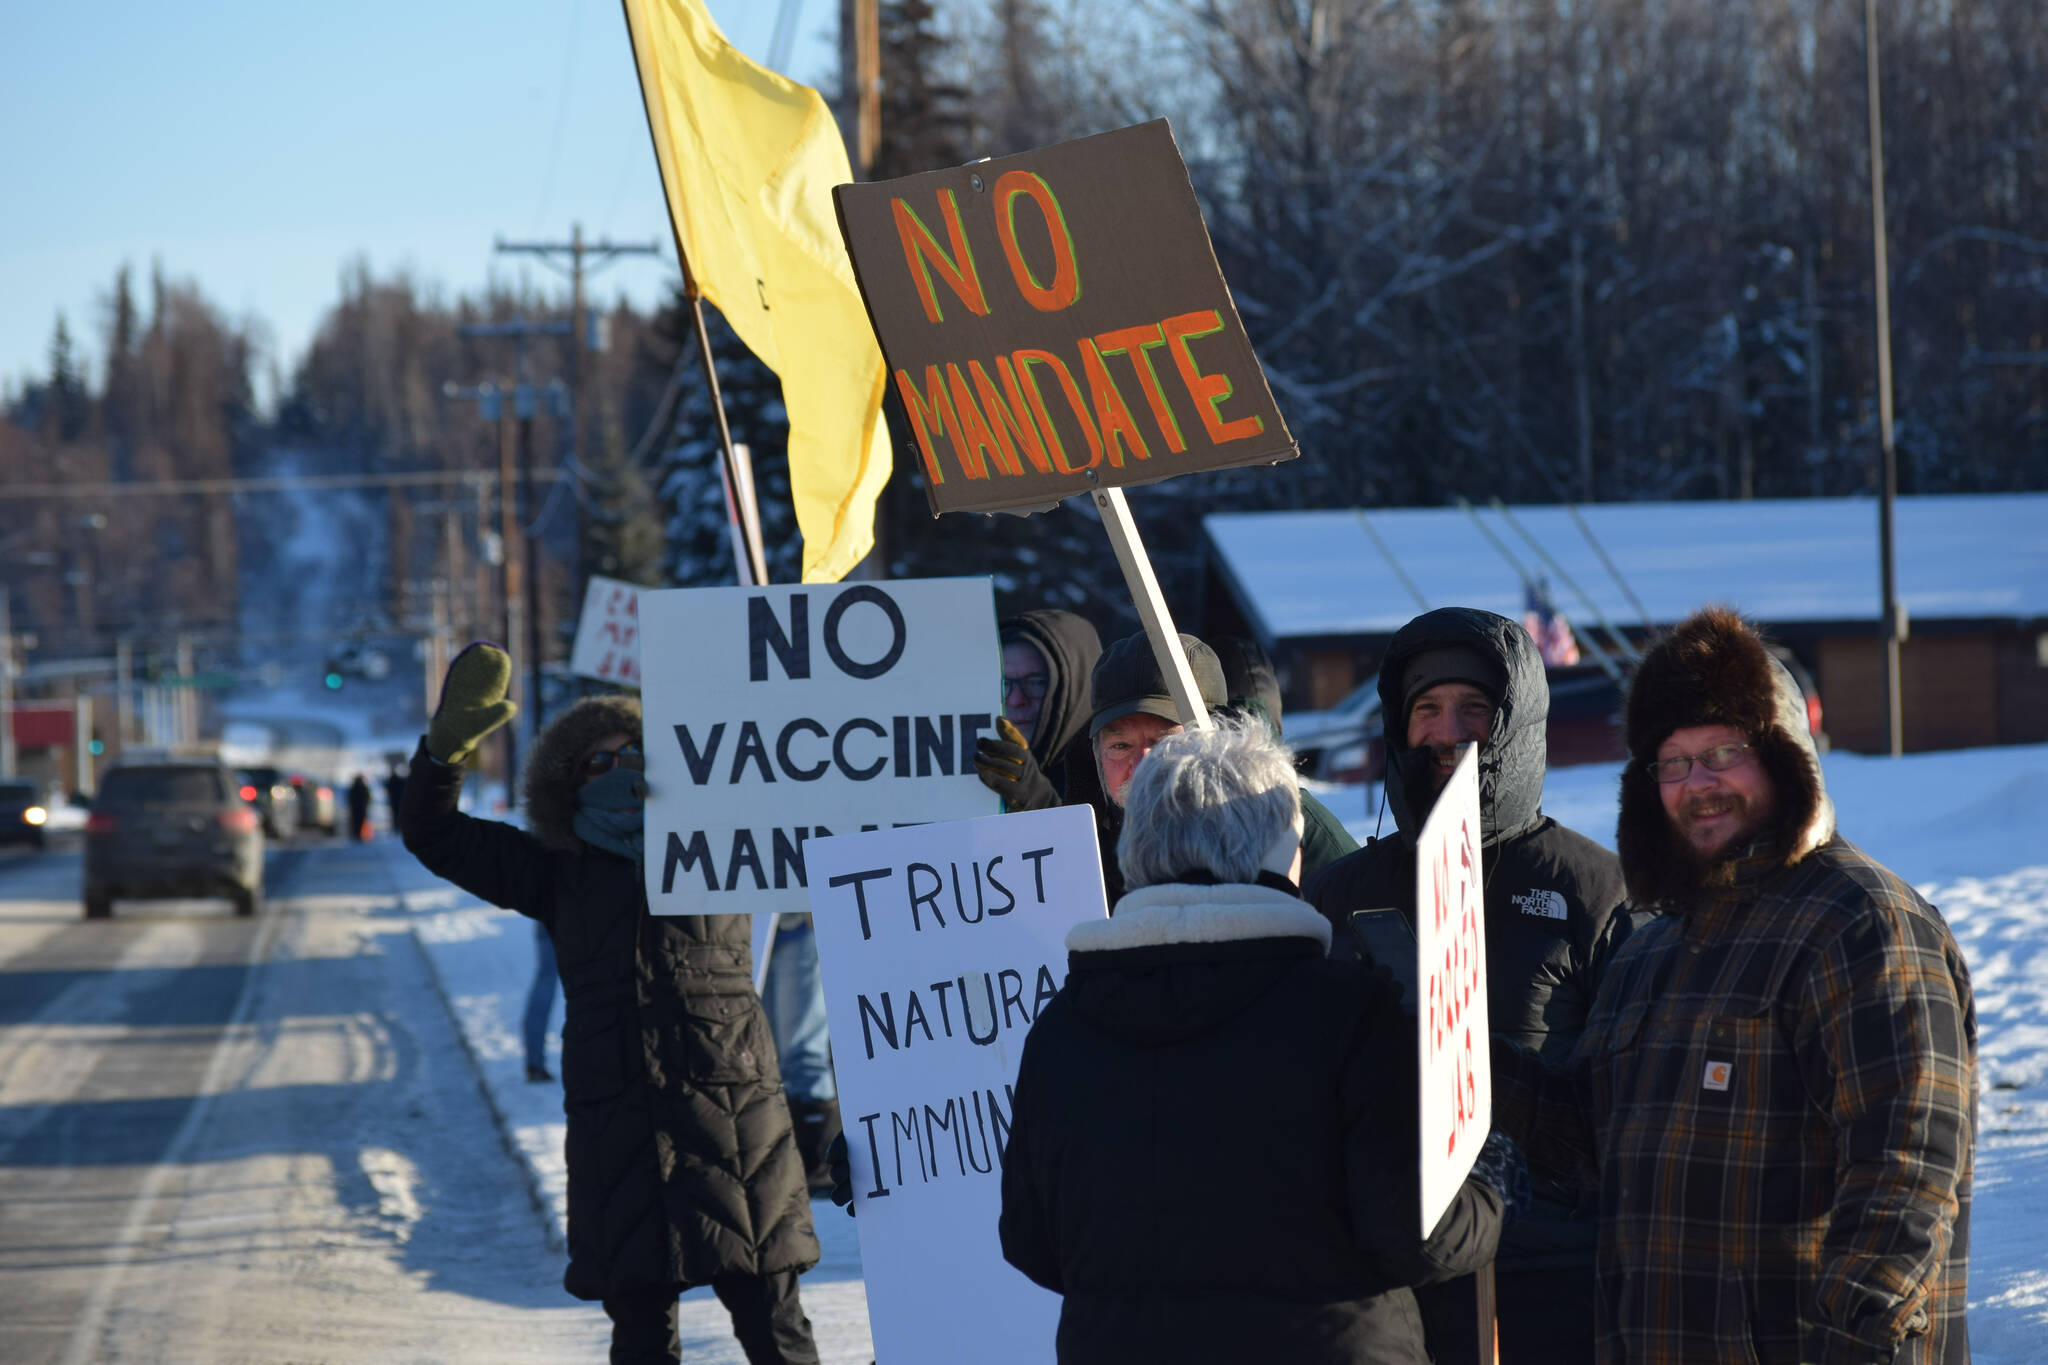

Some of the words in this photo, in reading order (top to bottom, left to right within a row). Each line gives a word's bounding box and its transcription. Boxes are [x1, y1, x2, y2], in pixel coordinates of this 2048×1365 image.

[890, 169, 1080, 323] NO
[895, 309, 1265, 485] MANDATE
[747, 584, 906, 682] NO
[673, 712, 992, 786] VACCINE
[829, 847, 1055, 941] TRUST
[1433, 832, 1450, 933] NO
[1511, 894, 1550, 908] NORTH
[1521, 905, 1548, 917] FACE
[1530, 888, 1551, 899] THE
[1429, 905, 1479, 1064] FORCED
[1447, 1026, 1476, 1159] JAB
